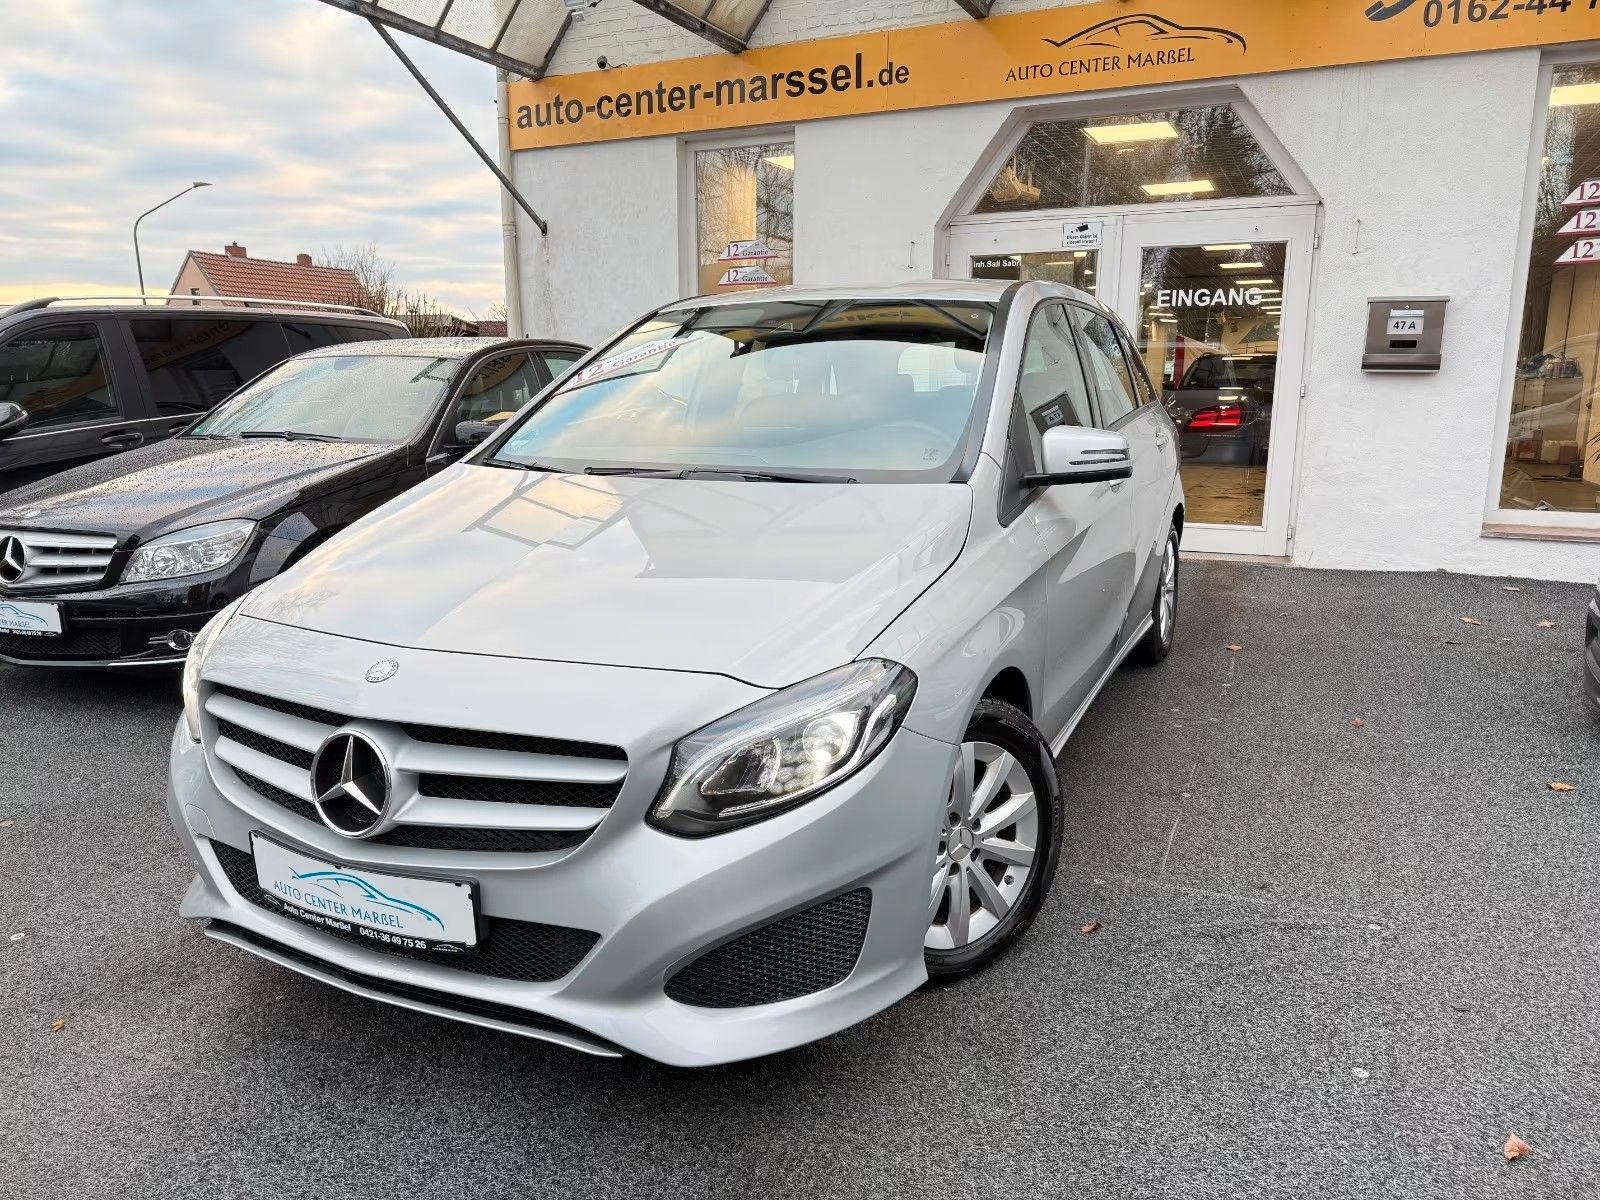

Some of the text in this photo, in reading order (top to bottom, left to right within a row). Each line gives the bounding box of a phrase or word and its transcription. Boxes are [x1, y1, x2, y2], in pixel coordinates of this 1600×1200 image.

[1005, 48, 1195, 82] AUTO CENTER MARßEL
[516, 52, 910, 129] auto-center-marssel.de
[1576, 182, 1600, 201] 12
[1573, 211, 1597, 230] 12
[726, 244, 768, 257] 12 Garantie
[1570, 241, 1594, 260] 12
[726, 269, 768, 282] 12 Garantie
[1157, 287, 1262, 307] EINGANG
[1393, 320, 1416, 330] 47 A
[274, 880, 404, 929] AUTO CENTER MARßEL
[283, 902, 299, 916] Auto
[300, 908, 324, 924] Center
[359, 927, 391, 943] 0421-36
[391, 935, 402, 945] 49
[402, 937, 414, 947] 75
[414, 939, 427, 949] 26
